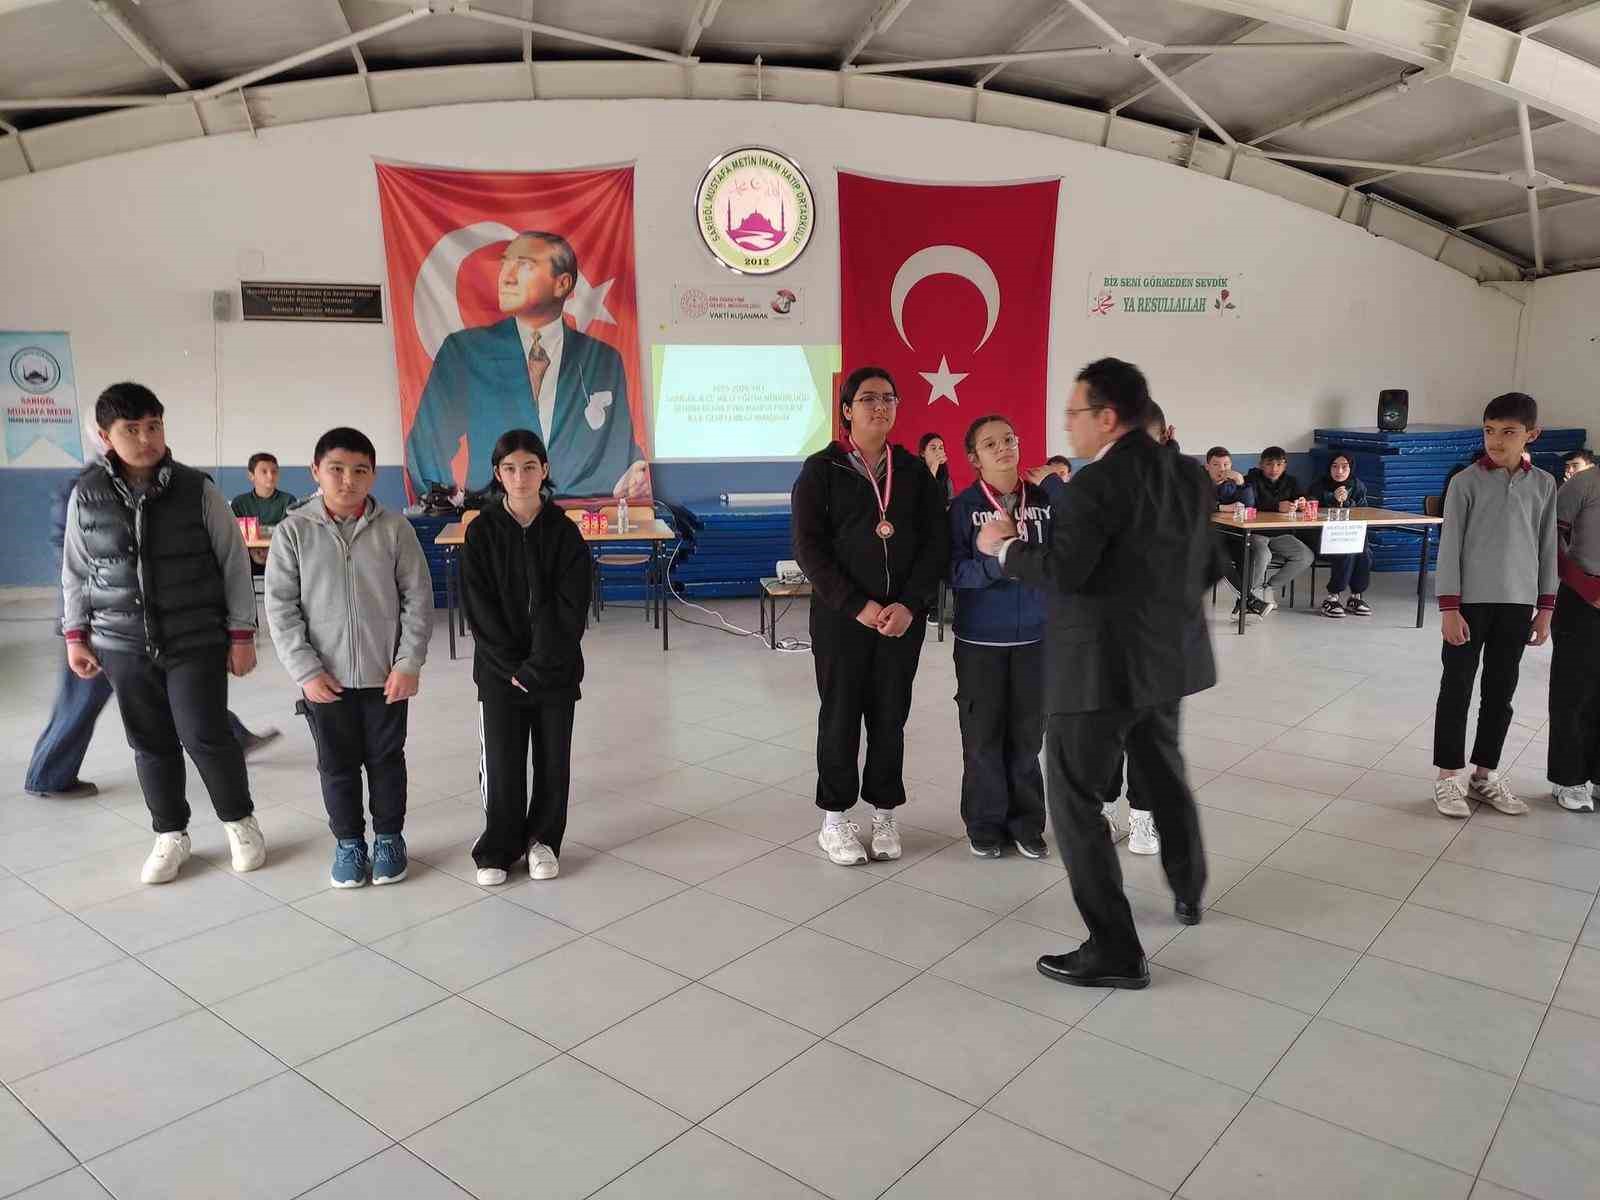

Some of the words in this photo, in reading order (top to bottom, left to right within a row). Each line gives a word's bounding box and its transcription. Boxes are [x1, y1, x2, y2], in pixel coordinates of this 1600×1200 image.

[705, 166, 732, 201] MUSTAFA
[731, 155, 757, 169] METİN
[744, 257, 770, 266] 2012
[1103, 275, 1119, 287] BİZ
[1143, 275, 1193, 288] GÖRMEDEN
[1195, 275, 1228, 287] SEVDİK
[1123, 297, 1135, 312] YA
[1137, 297, 1206, 312] RESULLALLAH
[972, 506, 1051, 526] COMUNITY
